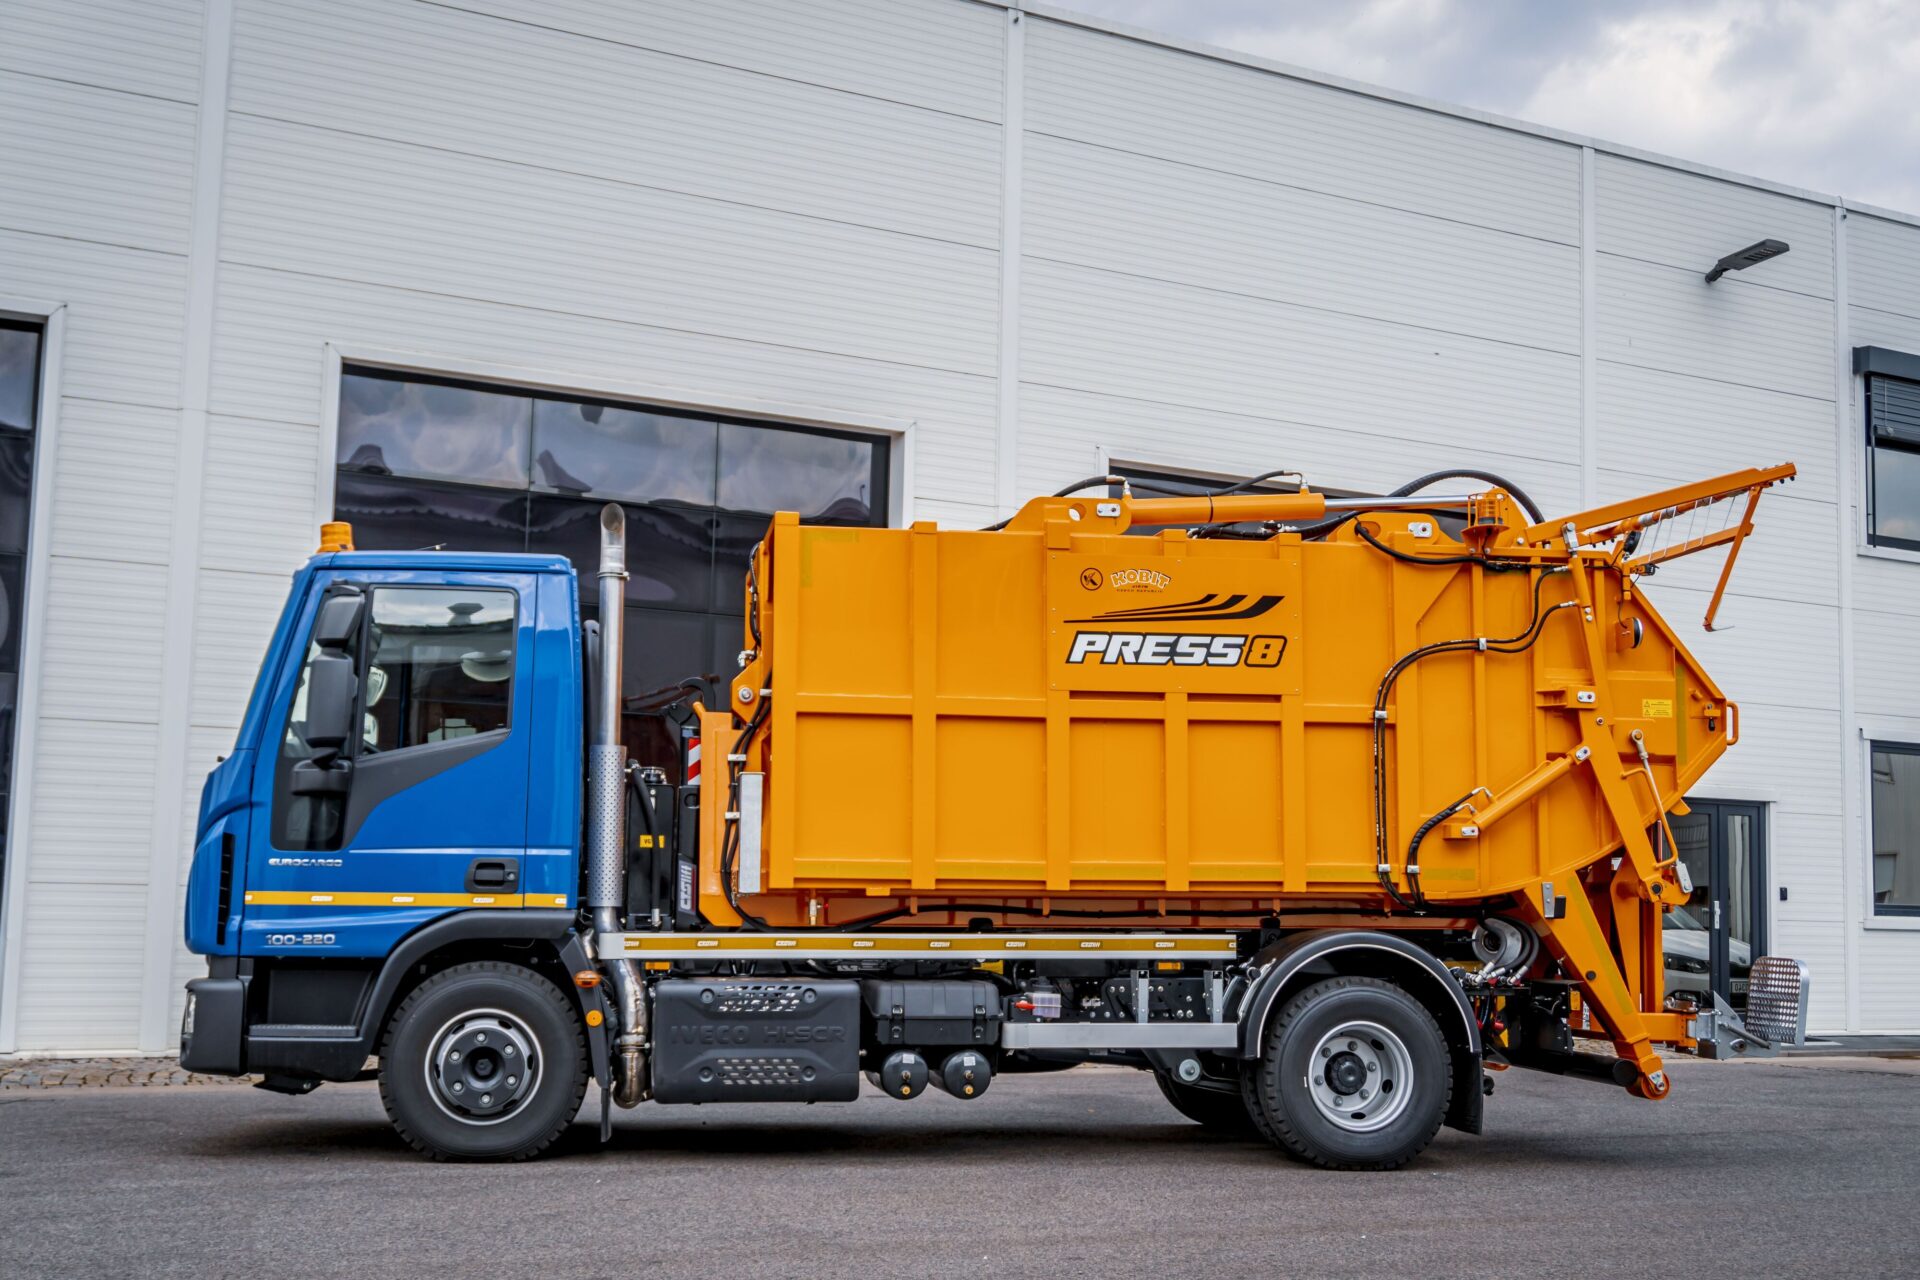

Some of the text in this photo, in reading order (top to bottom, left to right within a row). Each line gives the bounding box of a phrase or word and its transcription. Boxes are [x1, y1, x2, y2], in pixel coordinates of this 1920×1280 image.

[1110, 568, 1171, 589] KOBIT
[1065, 630, 1248, 667] PRESS
[268, 858, 343, 867] EUROCARGO
[265, 934, 336, 945] 100-220
[670, 1025, 847, 1045] IVECO HI-SCR
